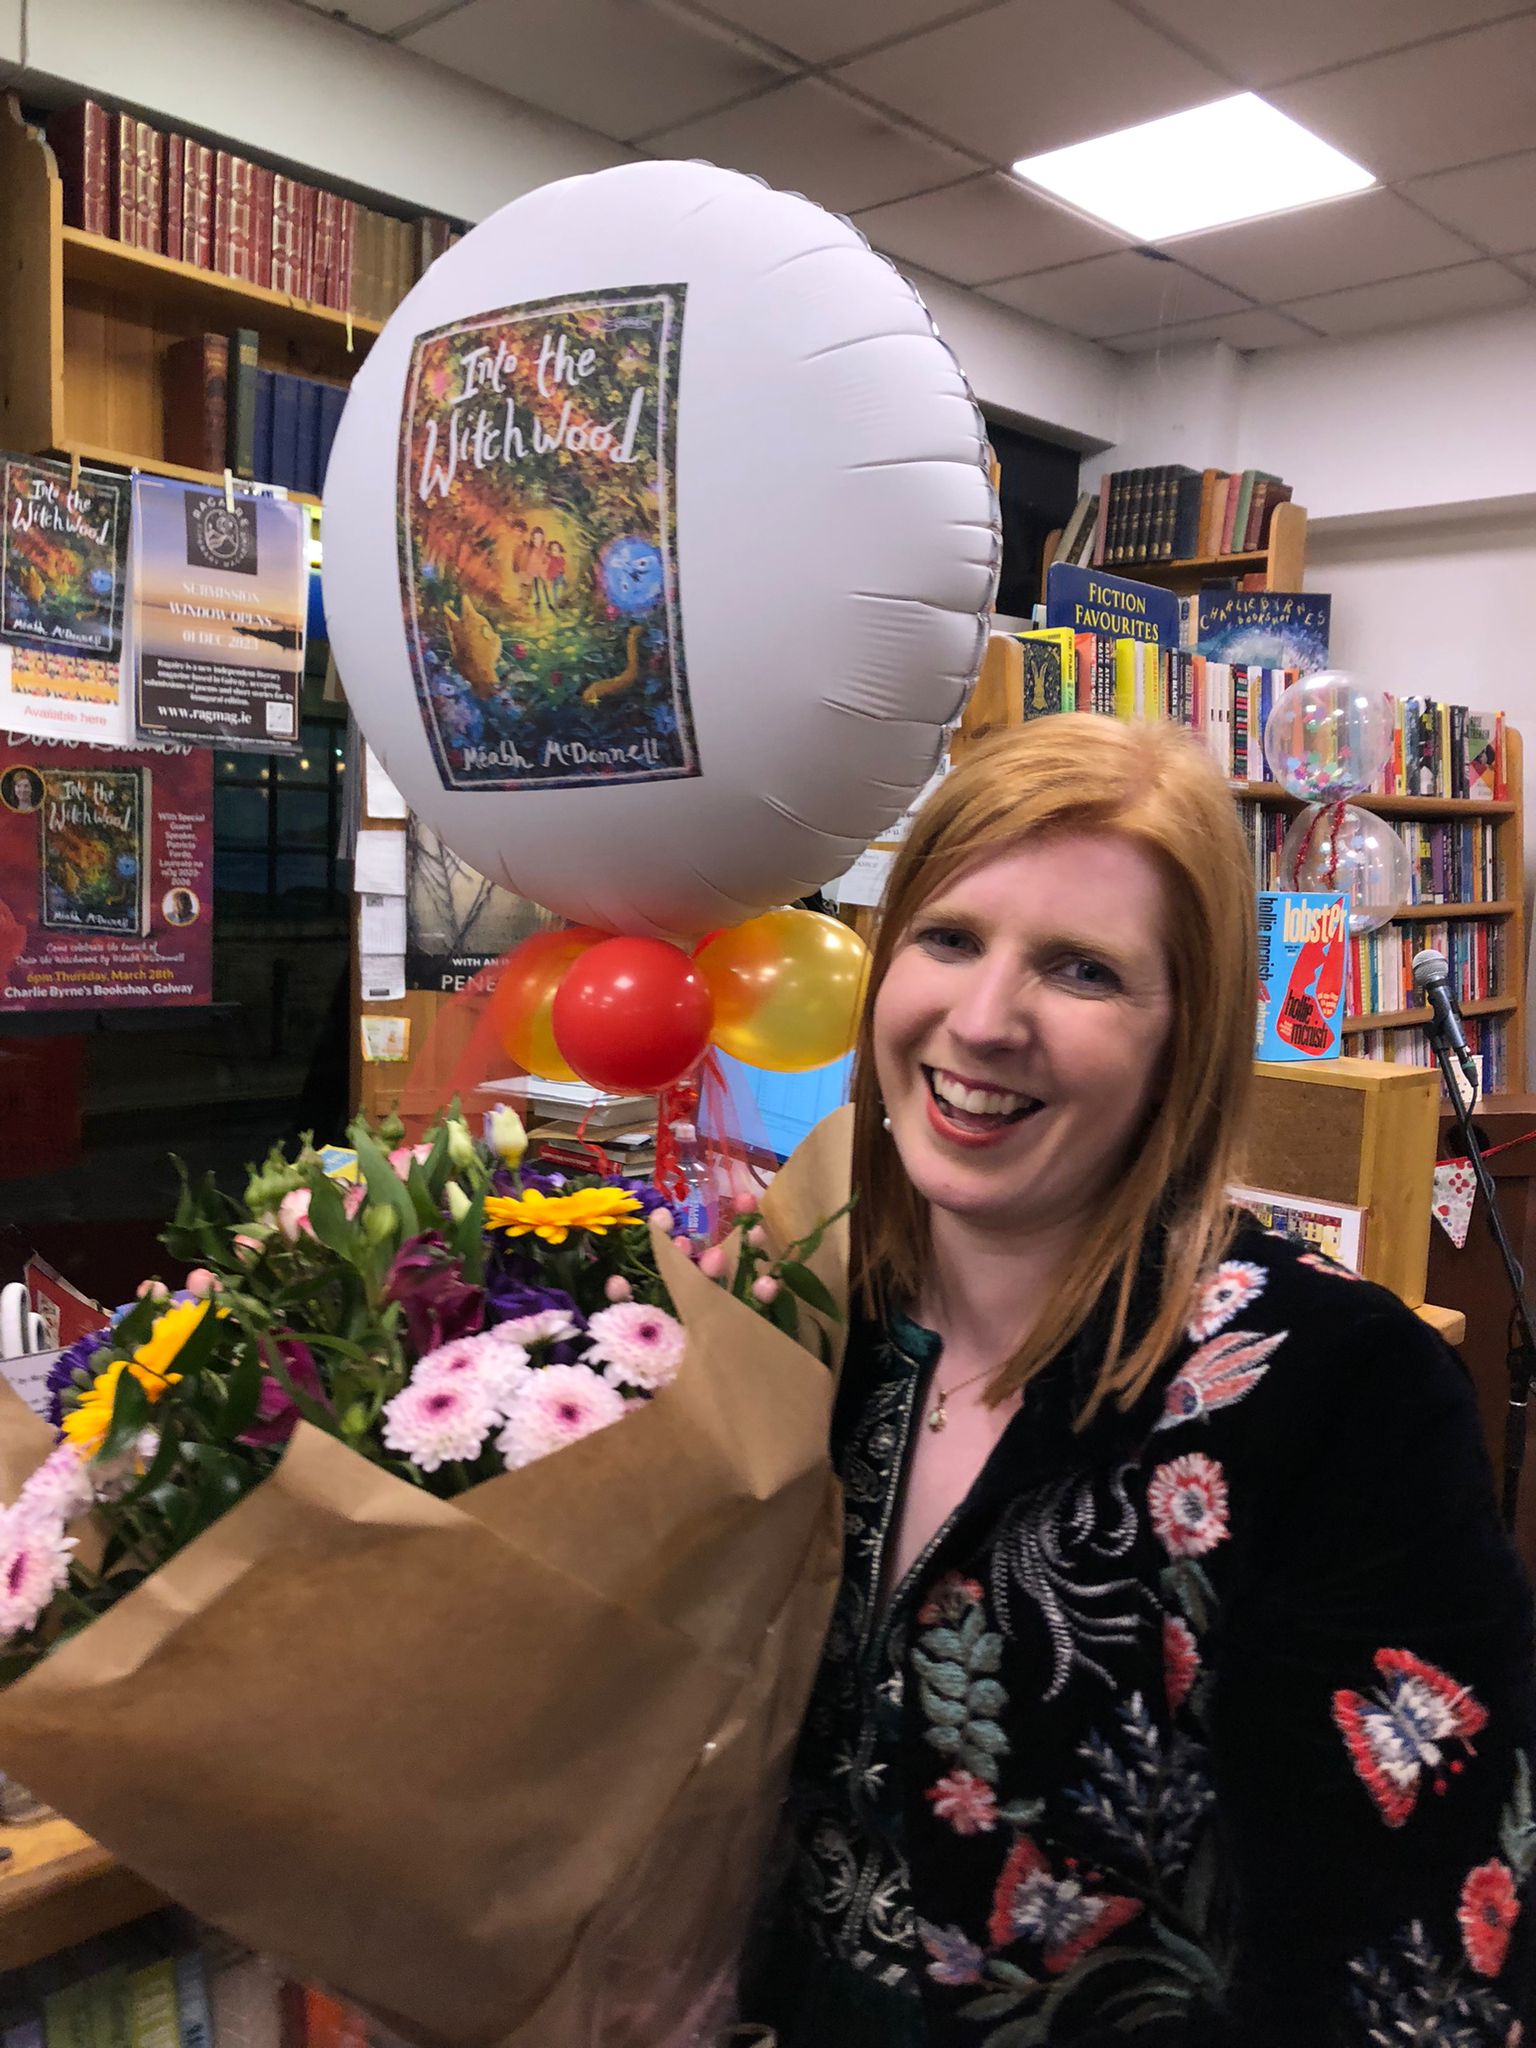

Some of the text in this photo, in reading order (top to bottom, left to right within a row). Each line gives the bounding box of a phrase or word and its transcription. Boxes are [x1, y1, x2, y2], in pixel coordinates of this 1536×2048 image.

[452, 334, 598, 403] Into the
[27, 479, 91, 513] Into the
[1089, 582, 1146, 614] FICTION
[169, 601, 273, 627] WINDOW OPENS
[1075, 603, 1159, 641] FAVOURITES
[1200, 598, 1255, 630] CHARLIE
[24, 706, 107, 726] Available here
[157, 705, 252, 725] www.ragmag.ie
[541, 737, 661, 767] McDonnell
[94, 782, 115, 805] the
[1283, 898, 1347, 943] lobster
[1257, 897, 1278, 981] hollie mcnish
[55, 971, 109, 983] Thursday,
[111, 970, 147, 981] March
[149, 969, 175, 981] 28th
[452, 958, 481, 967] WITH
[484, 958, 499, 967] AN
[4, 983, 194, 999] Charlie Byrne's Bookshop, Galway
[1284, 990, 1314, 1025] hollie
[1290, 1020, 1328, 1049] mcnish
